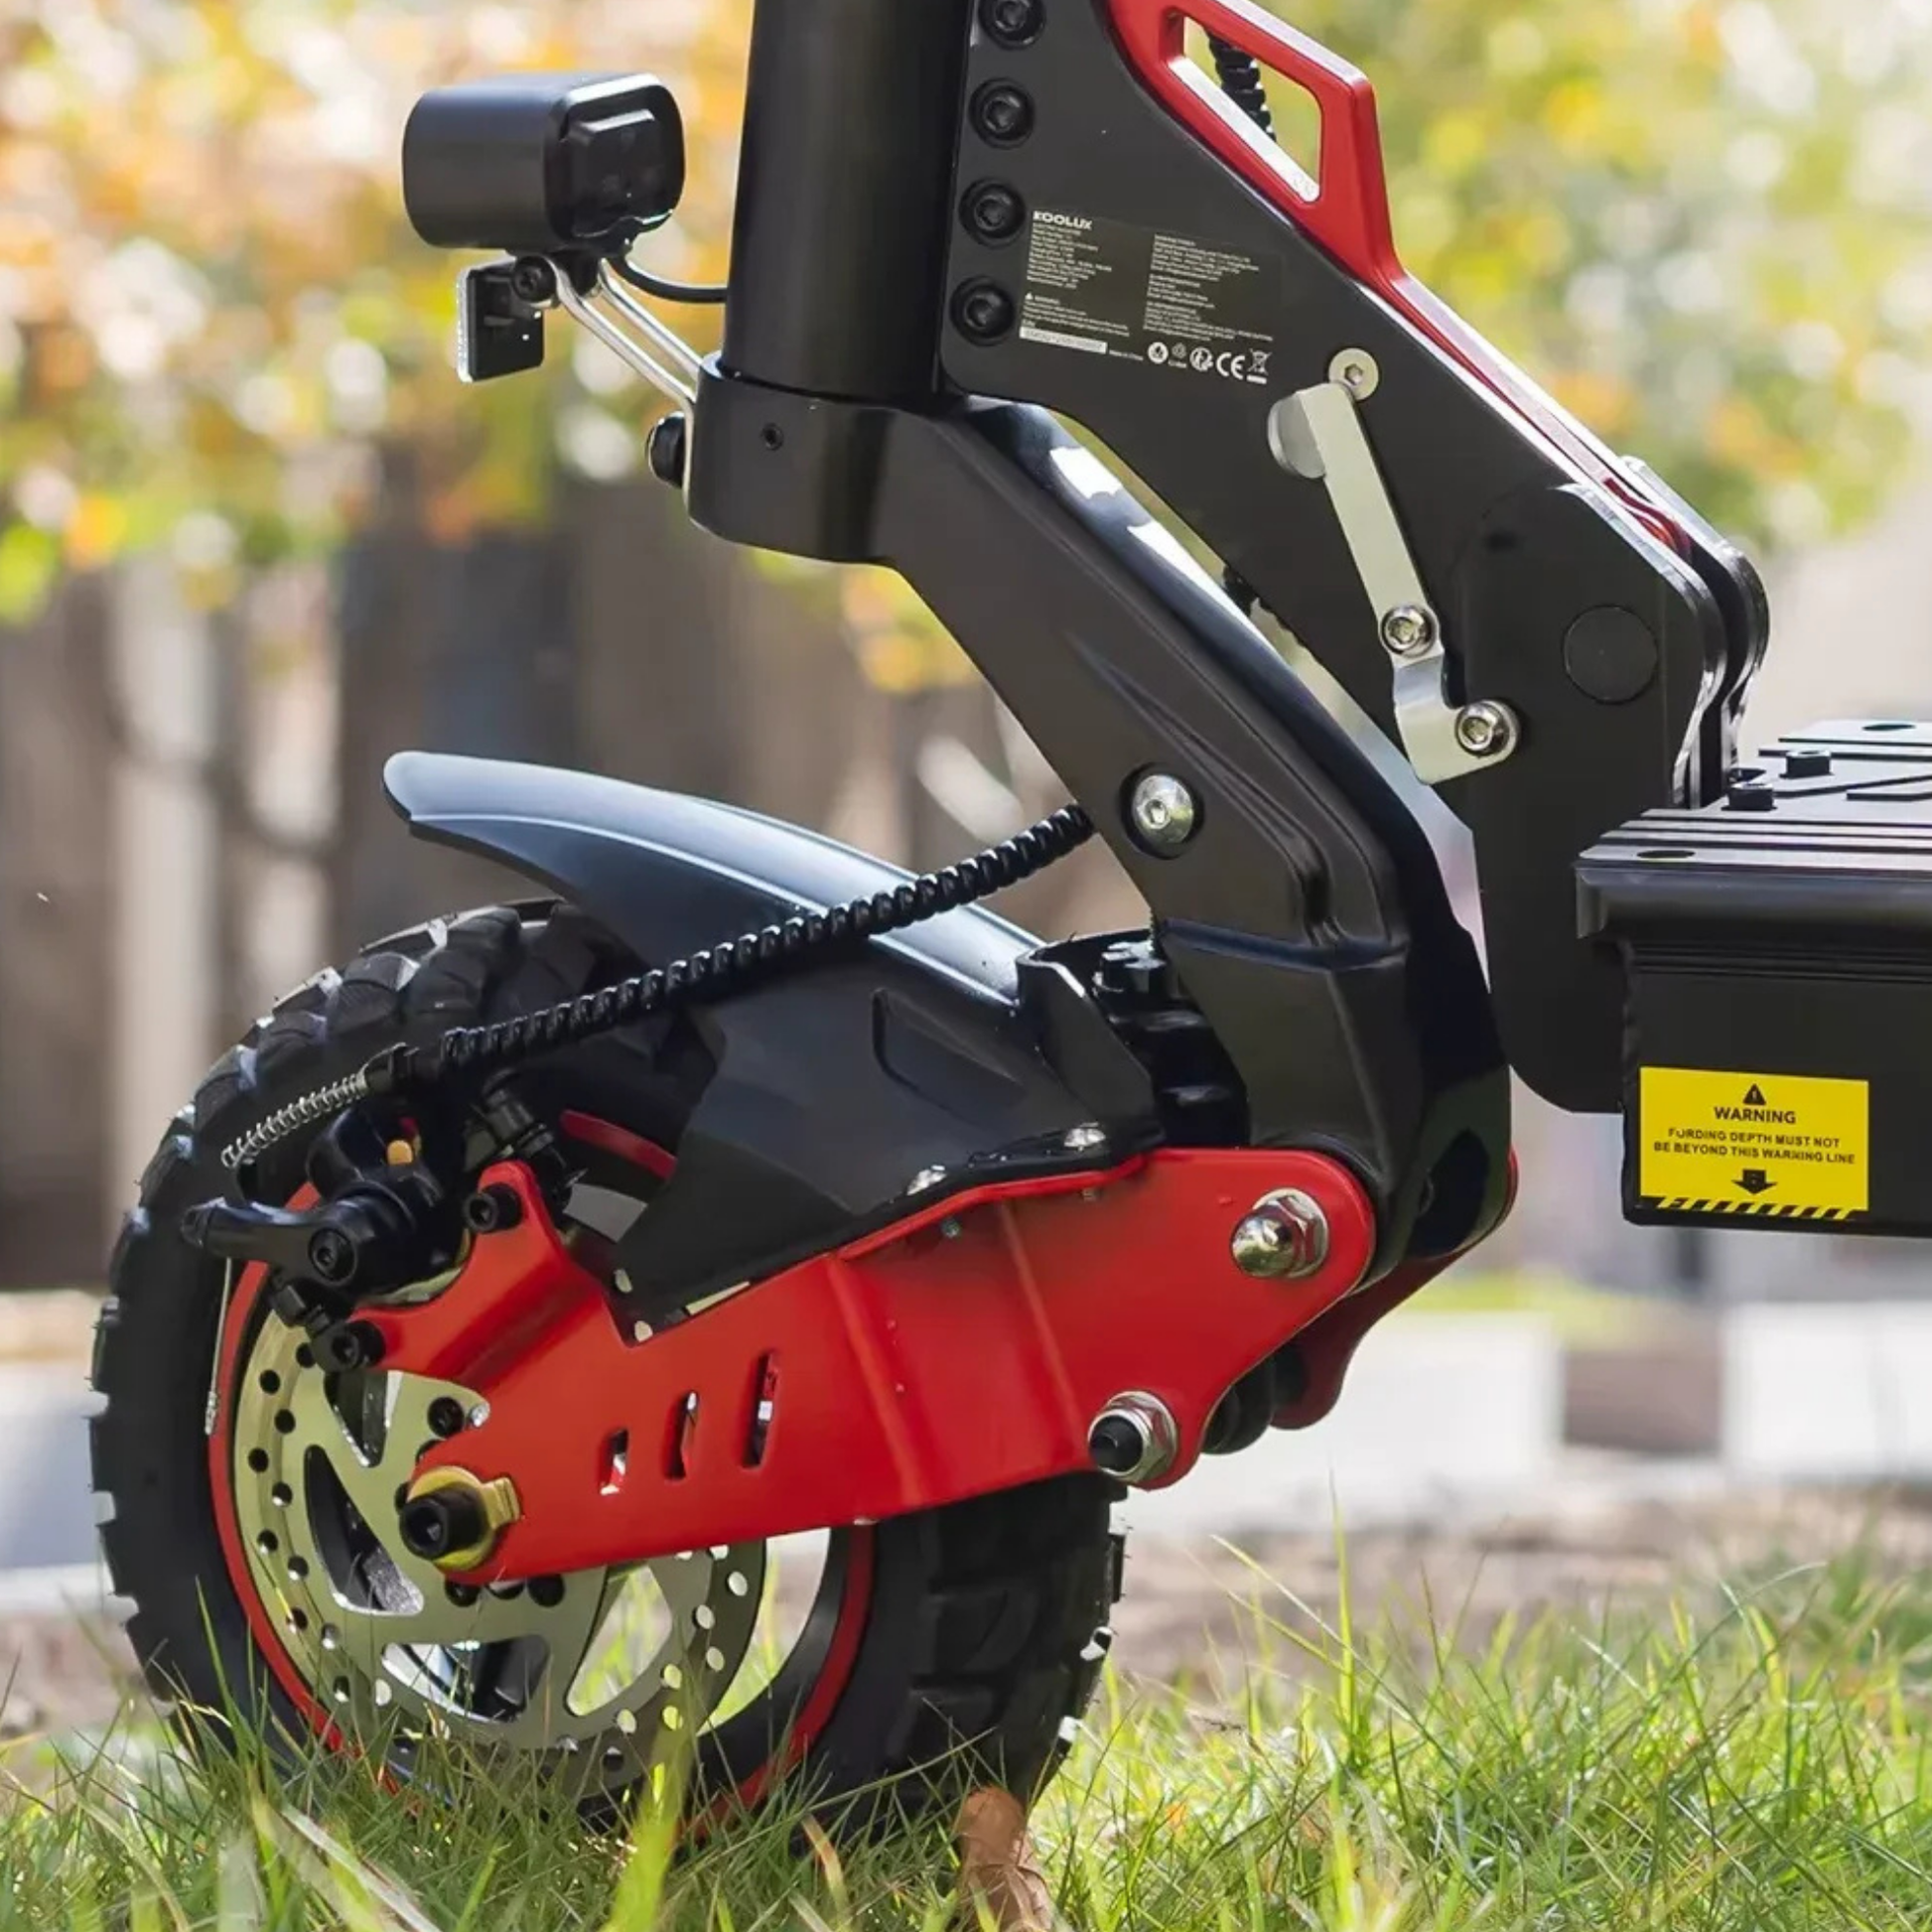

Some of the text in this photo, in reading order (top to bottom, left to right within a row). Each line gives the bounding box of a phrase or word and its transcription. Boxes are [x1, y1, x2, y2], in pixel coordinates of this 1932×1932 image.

[1714, 1107, 1796, 1124] WARNING
[1730, 1132, 1772, 1144] DEPTH
[1775, 1135, 1810, 1147] MUST
[1813, 1137, 1840, 1148] NOT
[1654, 1142, 1671, 1153] BE
[1674, 1143, 1727, 1156] BEYOND
[1731, 1146, 1759, 1159] THIS
[1827, 1153, 1856, 1165] LINE
